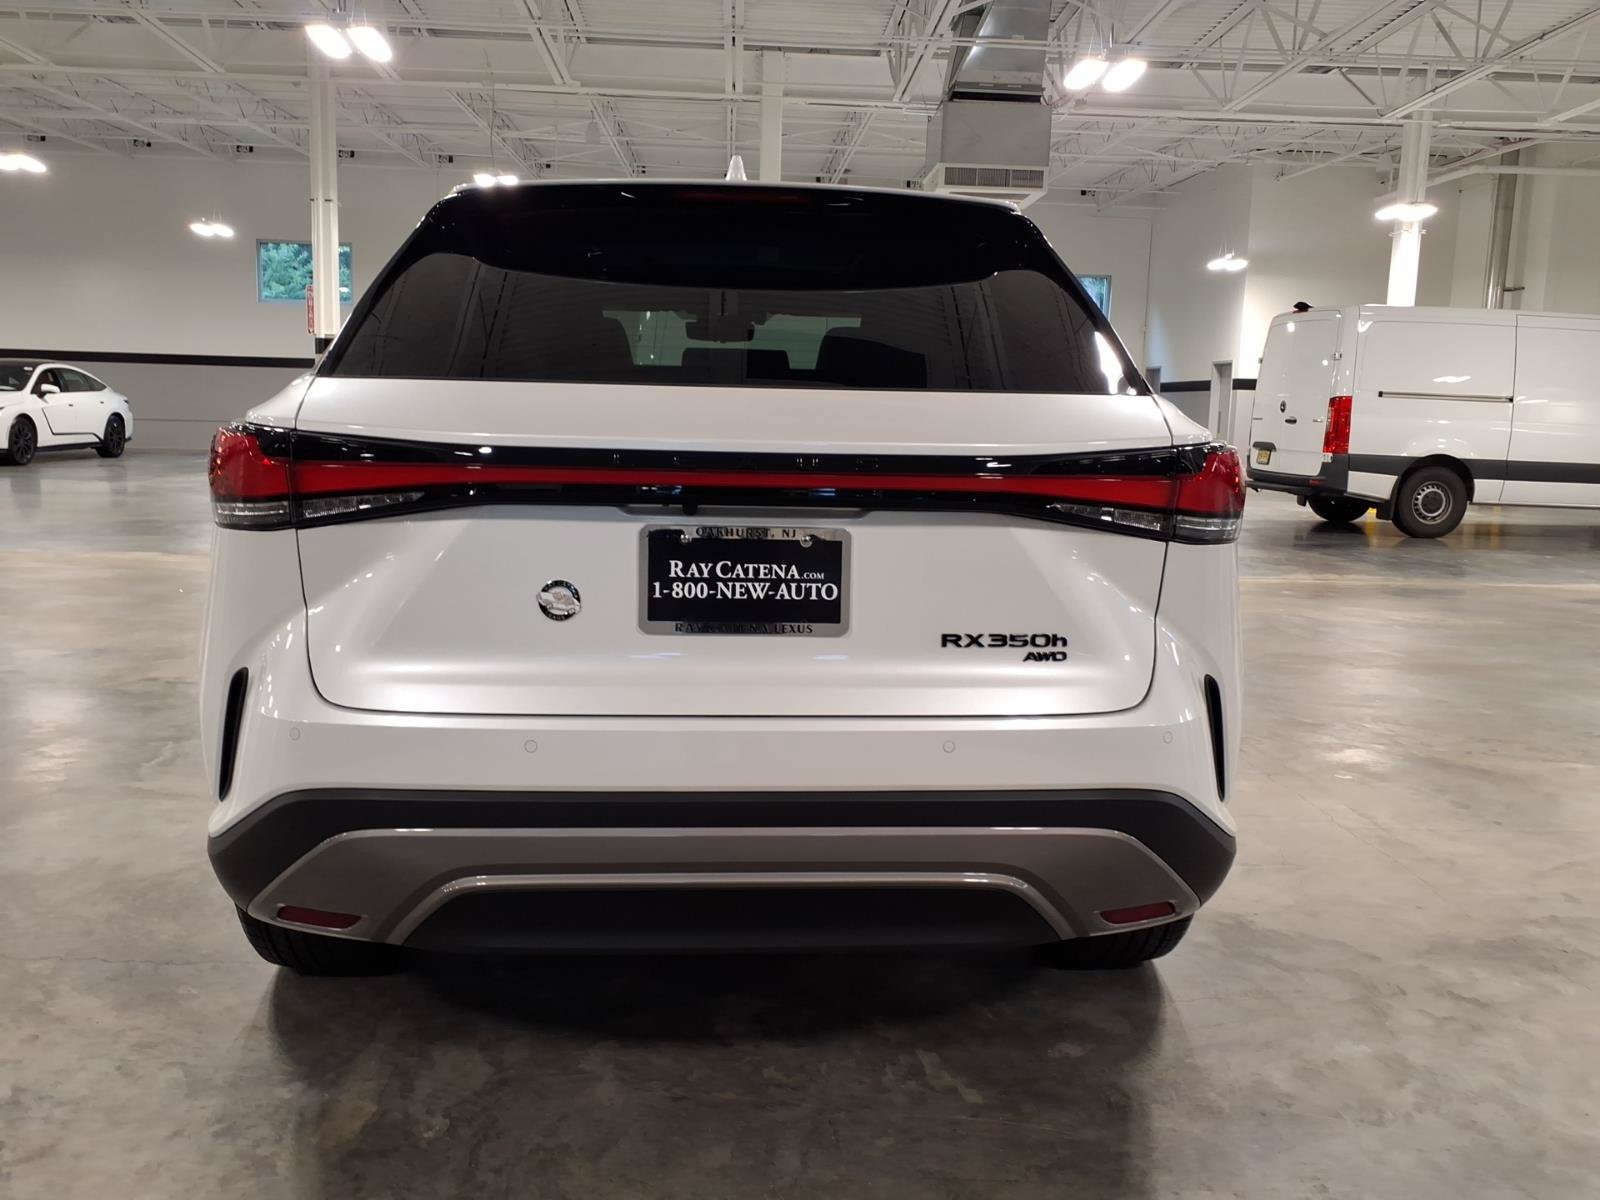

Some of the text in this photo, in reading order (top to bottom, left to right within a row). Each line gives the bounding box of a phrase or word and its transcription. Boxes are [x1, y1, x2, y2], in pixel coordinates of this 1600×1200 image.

[782, 528, 797, 539] NJ
[651, 581, 839, 600] 1-800-NEW-AUTO
[773, 624, 814, 634] LEXUS
[1022, 651, 1068, 662] AWD
